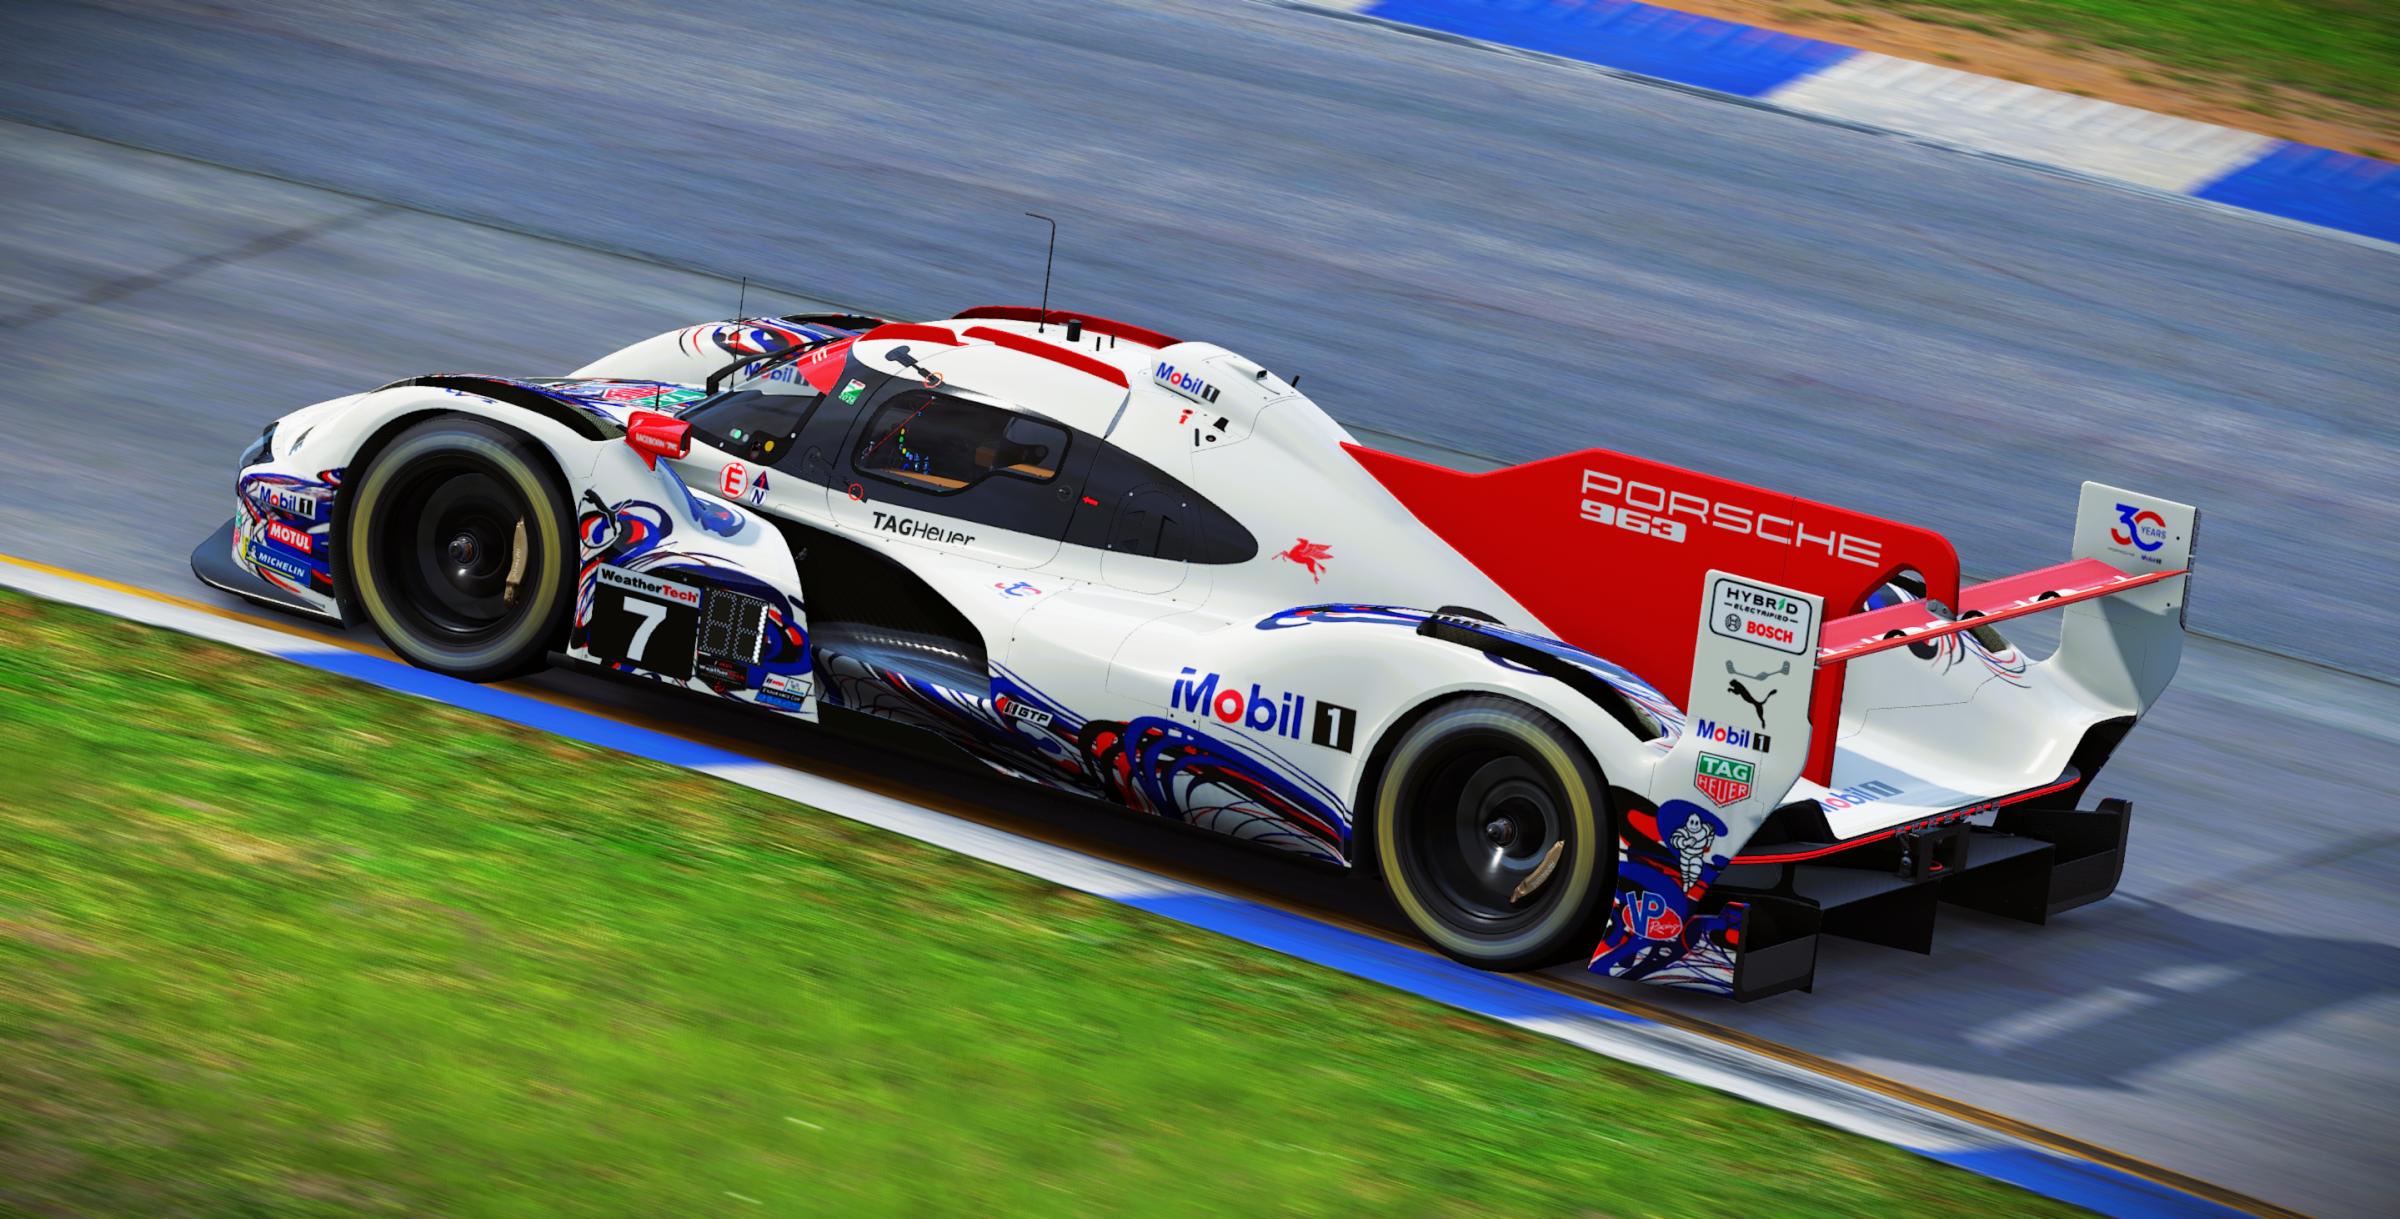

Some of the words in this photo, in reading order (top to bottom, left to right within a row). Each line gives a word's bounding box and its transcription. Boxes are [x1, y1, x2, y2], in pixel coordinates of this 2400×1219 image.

[1156, 361, 1203, 395] Mobil
[724, 466, 743, 495] E
[260, 485, 297, 512] Mobil
[751, 488, 765, 505] N
[1580, 499, 1687, 543] 963
[1581, 469, 1883, 568] PORSCHE
[2111, 503, 2167, 552] 30
[269, 522, 311, 550] MOTUL
[2141, 526, 2167, 540] YEARS
[258, 552, 305, 578] MICHELIN
[601, 568, 698, 603] WeatherTech
[1726, 587, 1799, 615] HYBRID
[1733, 602, 1789, 623] ELECTRIFIED
[623, 595, 668, 662] 7
[1746, 620, 1794, 644] BOSCH
[1018, 706, 1050, 722] GTP
[1171, 667, 1305, 740] Mobil
[1696, 719, 1750, 749] Mobil
[1703, 756, 1749, 781] TAG
[1697, 775, 1749, 803] HEUER
[1625, 890, 1667, 938] VP
